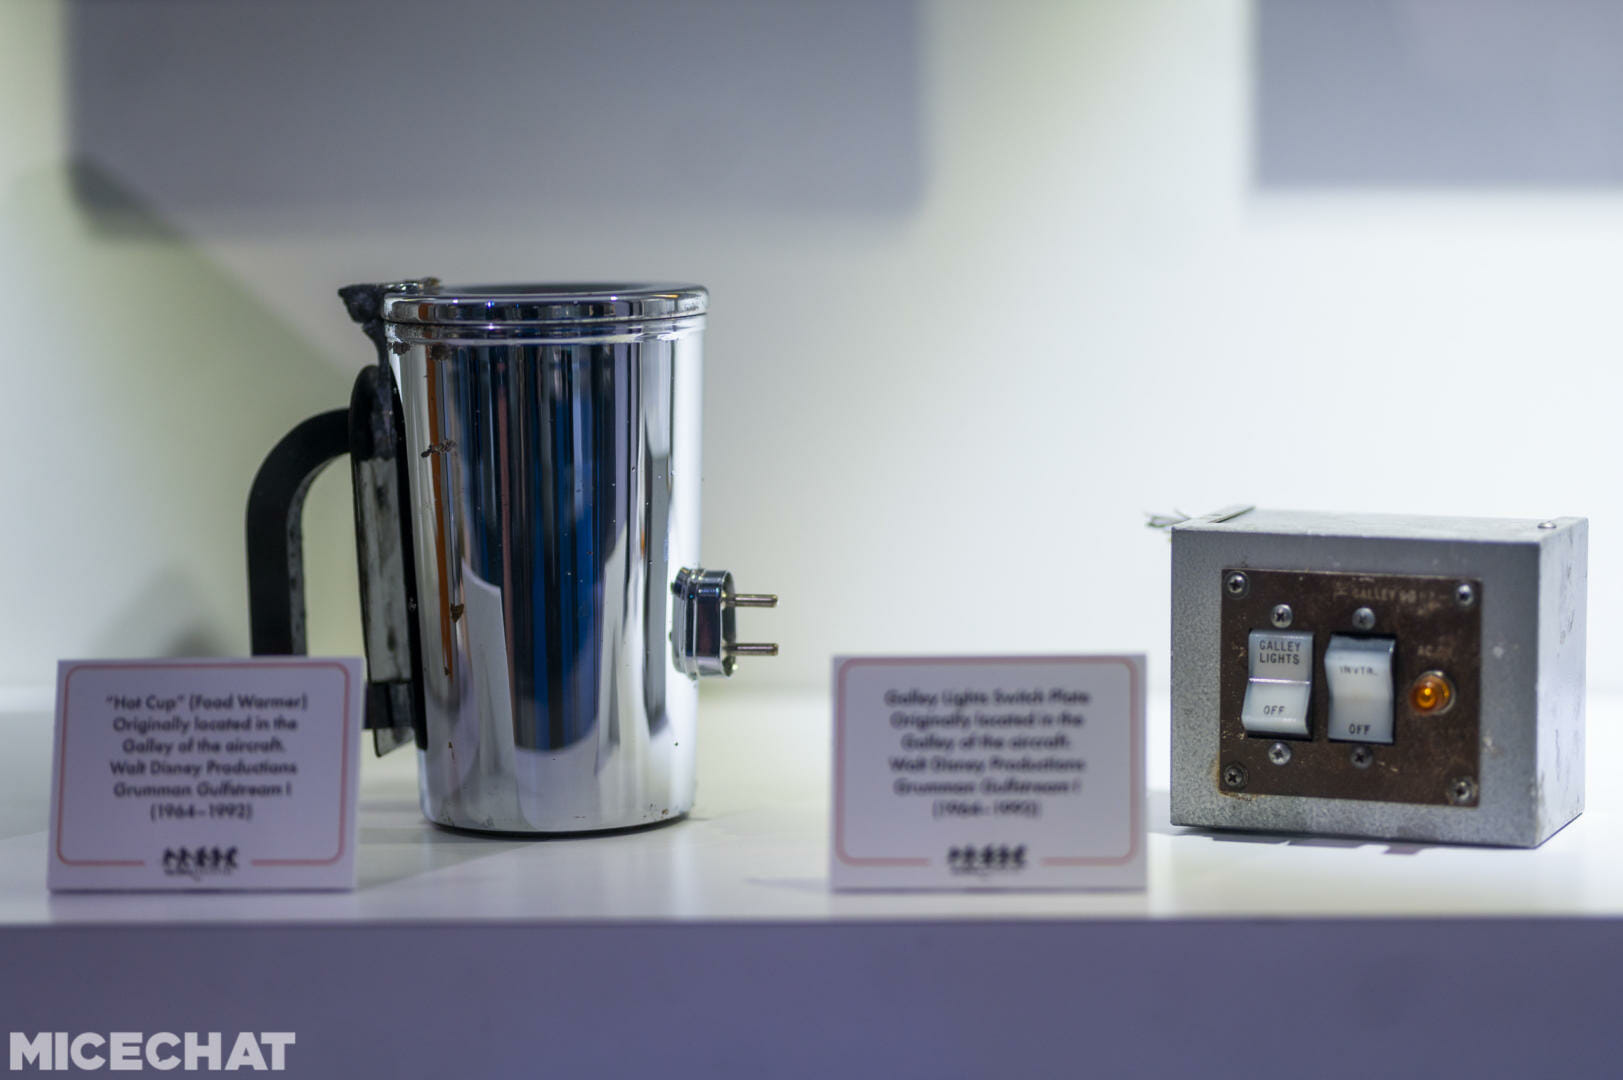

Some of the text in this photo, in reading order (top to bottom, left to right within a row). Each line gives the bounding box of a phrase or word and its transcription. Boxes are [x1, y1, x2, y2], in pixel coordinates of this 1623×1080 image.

[1259, 640, 1301, 652] GALLEY
[1259, 653, 1300, 665] LIGHTS
[189, 693, 233, 710] (Food
[238, 693, 307, 710] Warmer)
[884, 689, 1089, 708] Galley Lights Switch Plate
[1263, 705, 1285, 715] OFF
[113, 715, 298, 734] Originally located in the
[890, 711, 1084, 730] Originally located in the
[1349, 724, 1371, 735] OFF
[122, 737, 285, 755] Galley of the aircraft.
[900, 734, 953, 752] Galley
[960, 734, 975, 749] of
[980, 734, 1003, 749] the
[110, 759, 298, 777] Walt Disney Productions
[889, 756, 1086, 774] Walt Disney Productions
[113, 782, 191, 797] Grumman
[197, 781, 282, 797] Gulfstream
[893, 778, 974, 795] Grumman
[980, 778, 1069, 794] Gulfstream
